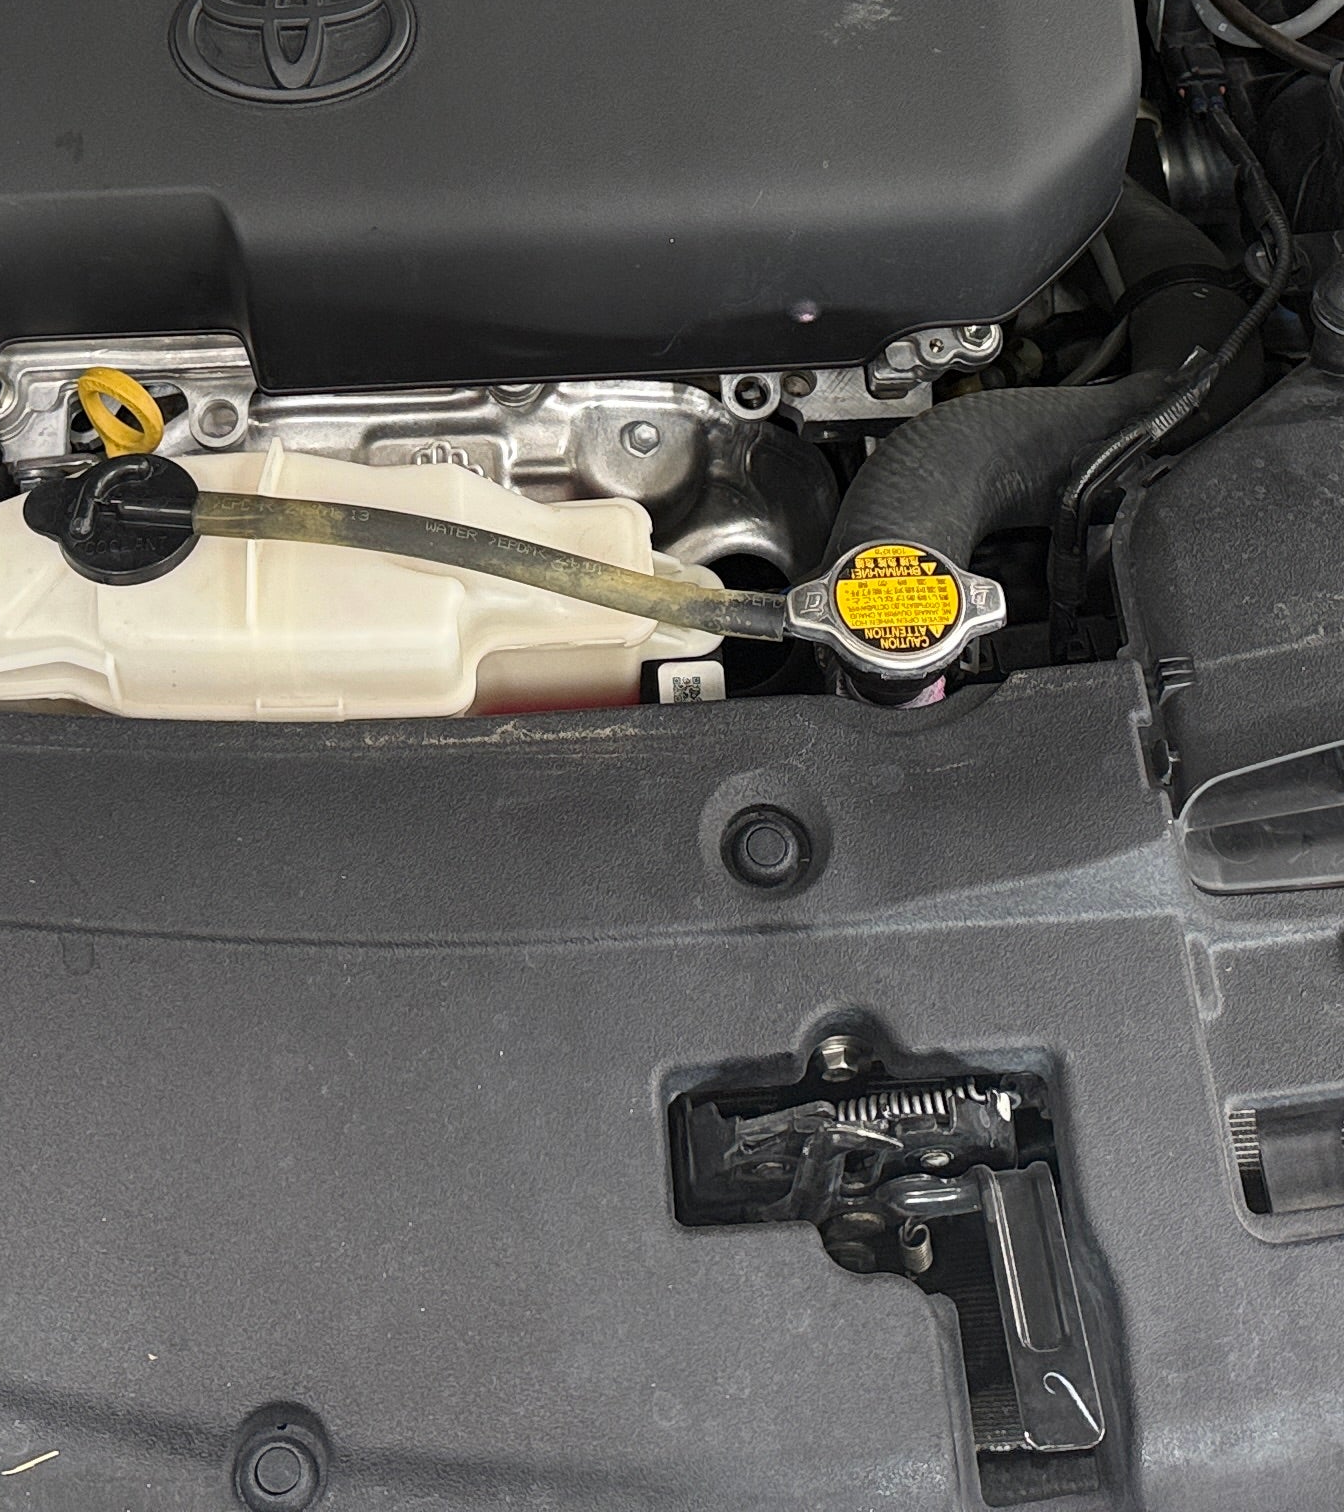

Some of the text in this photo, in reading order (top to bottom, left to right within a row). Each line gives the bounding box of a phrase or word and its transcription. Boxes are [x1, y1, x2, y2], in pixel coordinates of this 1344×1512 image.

[424, 521, 479, 542] WATER
[851, 566, 921, 578] ВНИМАНИЕ!
[864, 625, 927, 639] ATTENTION
[880, 636, 929, 649] CAUTION
